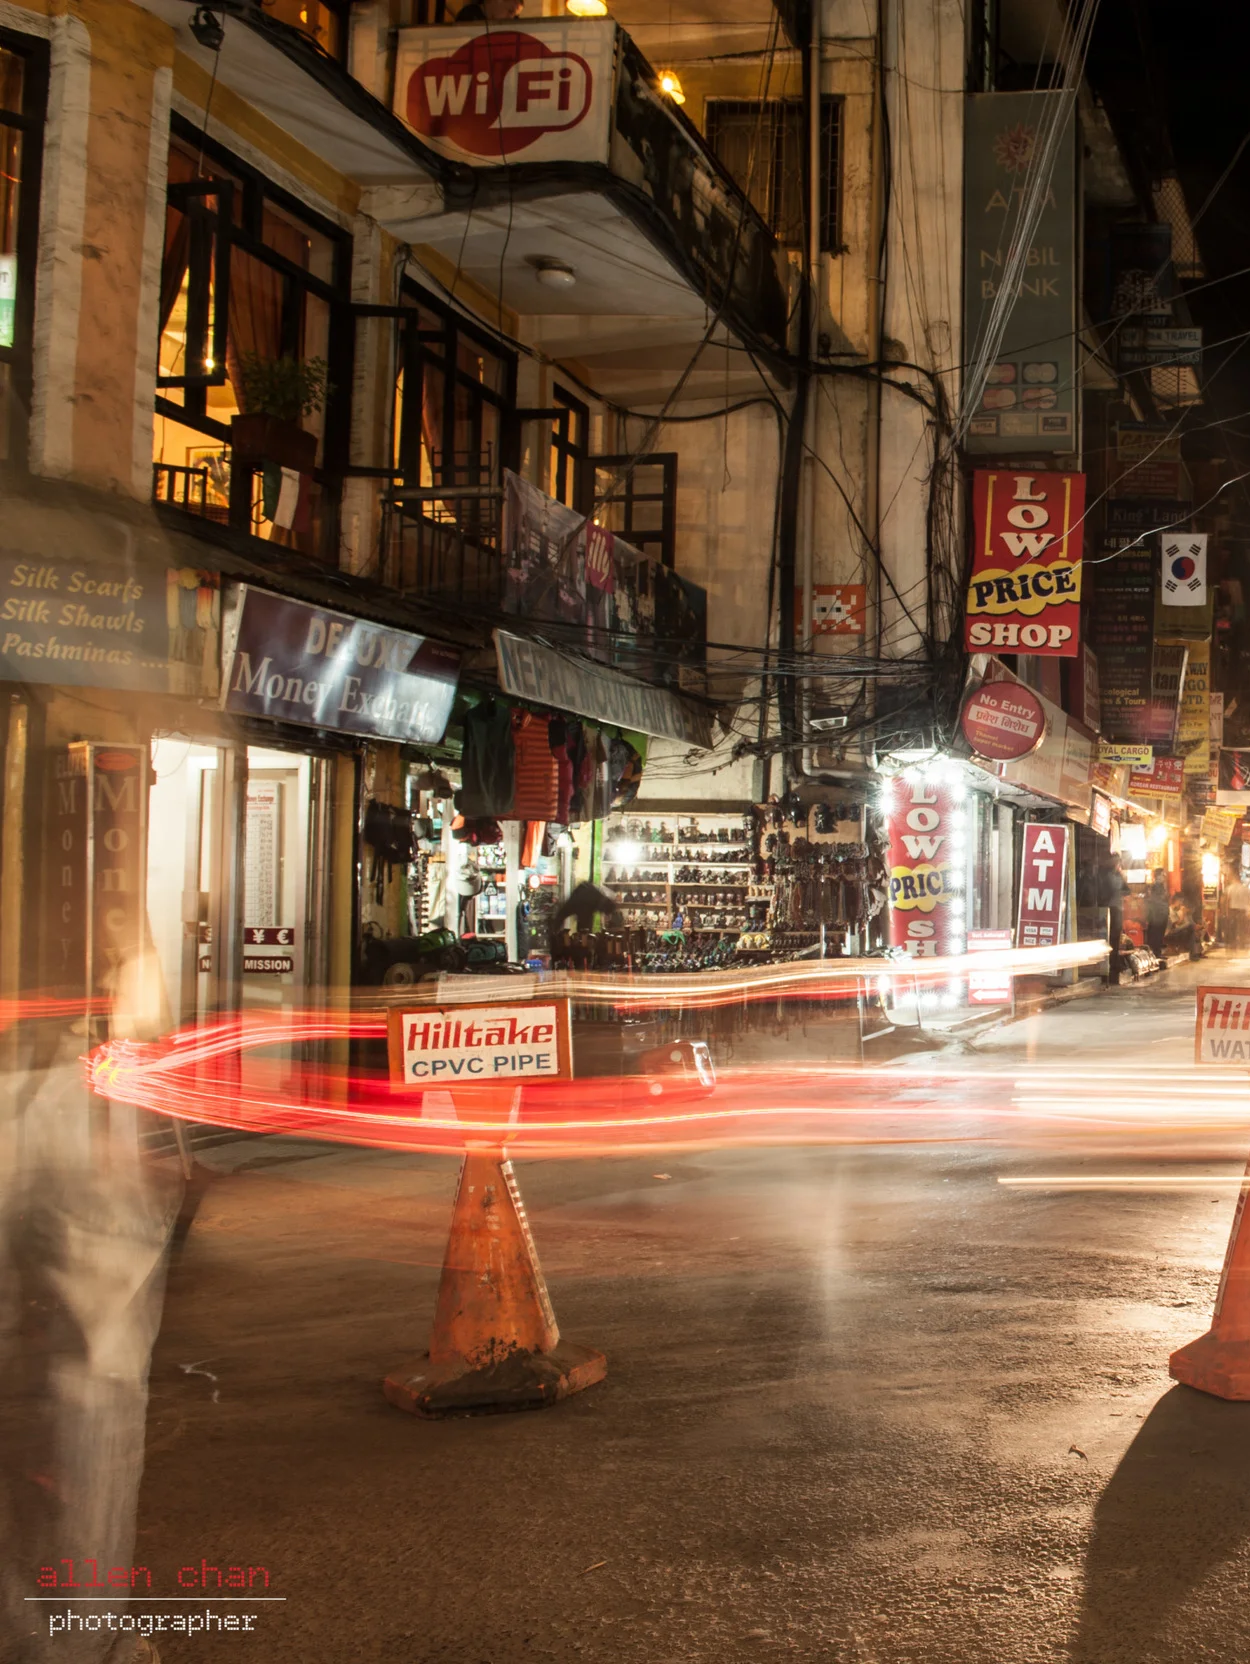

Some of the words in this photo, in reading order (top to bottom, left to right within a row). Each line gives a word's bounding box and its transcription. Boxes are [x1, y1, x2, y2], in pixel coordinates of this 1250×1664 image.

[979, 247, 1062, 269] NBIL
[1000, 476, 1056, 558] LOW
[587, 531, 611, 583] illy
[10, 564, 60, 590] Silk
[67, 571, 145, 603] Scarfs
[974, 566, 1077, 609] PRICE
[0, 597, 51, 623] Silk
[58, 603, 146, 633] Shawls
[2, 632, 134, 666] Pashminas
[306, 617, 413, 674] DEUXE
[970, 623, 1073, 650] SHOP
[231, 650, 333, 721] Money
[980, 693, 998, 707] No
[1001, 700, 1036, 720] Entry
[1097, 746, 1119, 755] OYAL
[1121, 747, 1149, 756] CARGO
[1027, 830, 1056, 912] ATM
[407, 1017, 554, 1051] Hilltake
[411, 1056, 484, 1077] CPVC
[493, 1053, 551, 1072] PIPE
